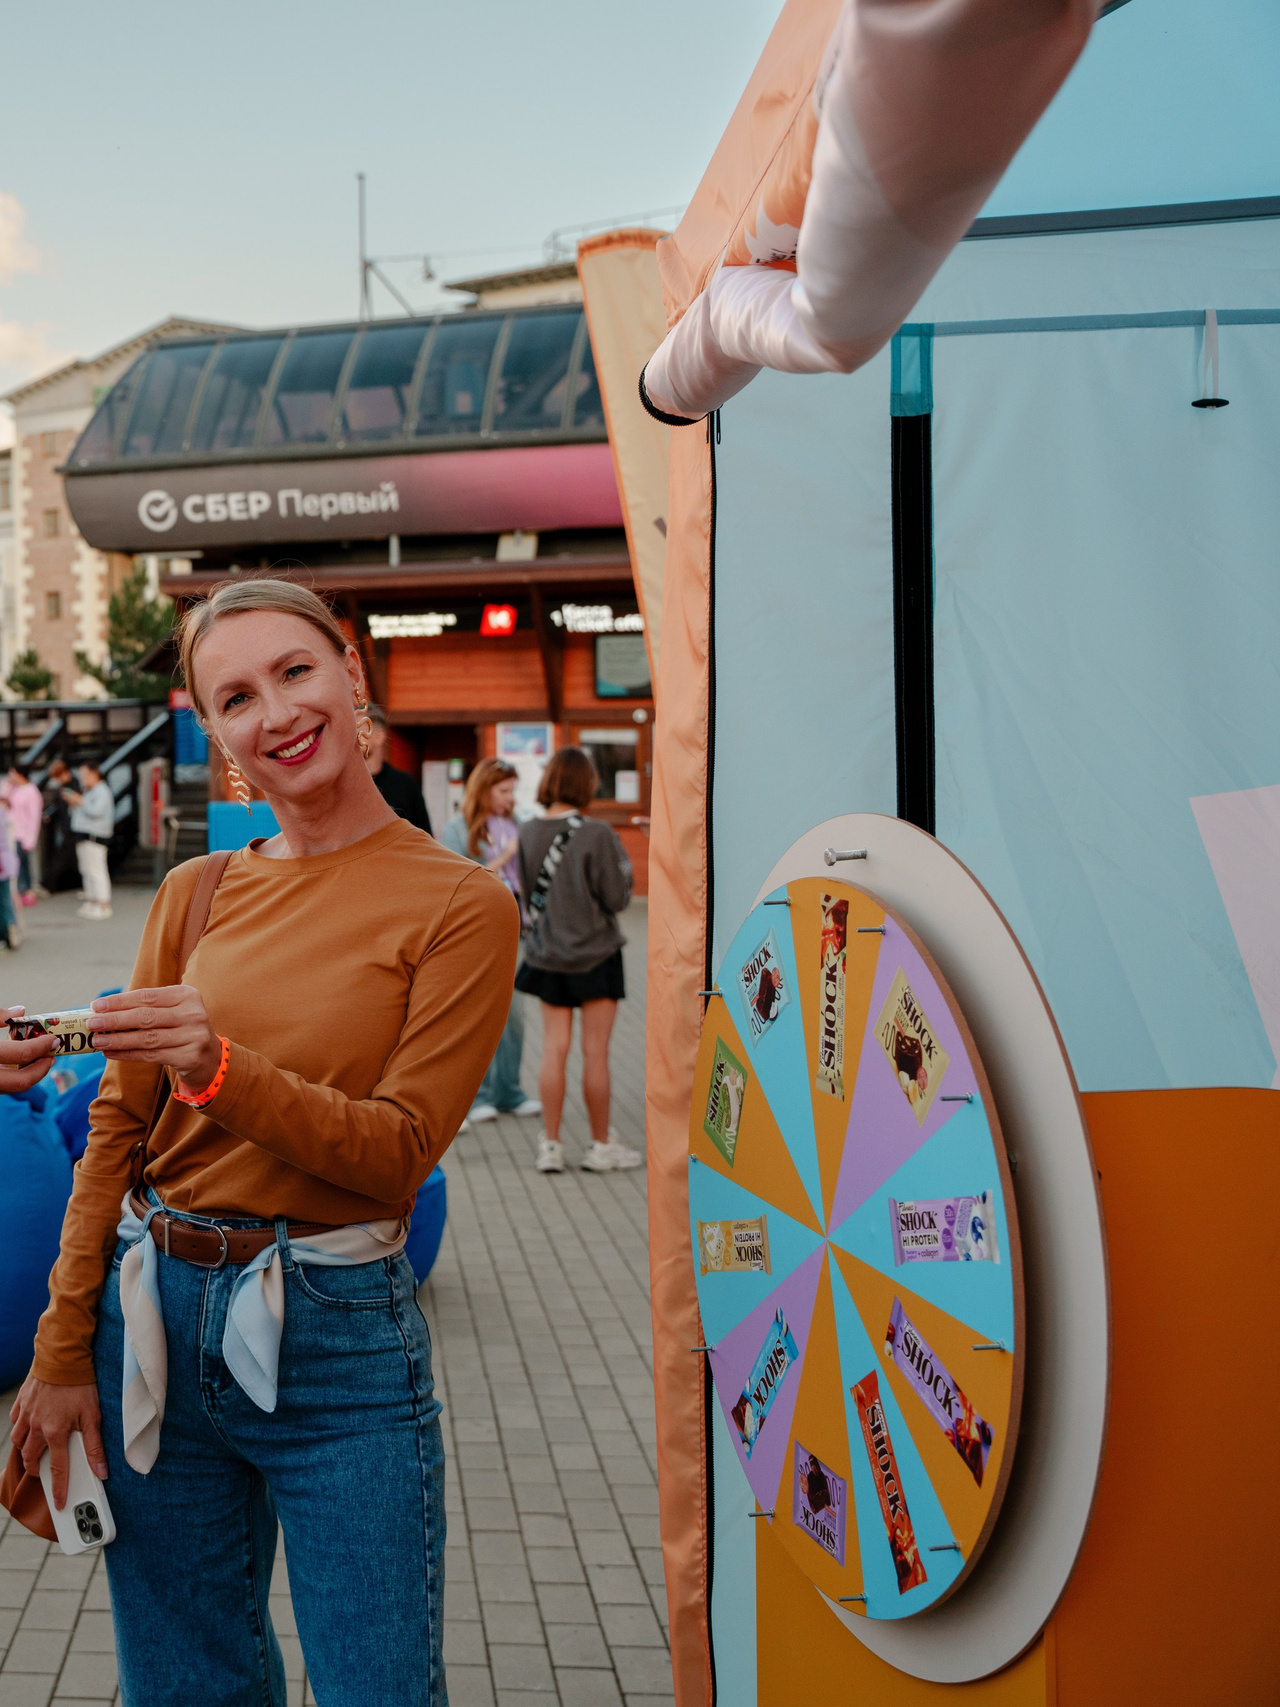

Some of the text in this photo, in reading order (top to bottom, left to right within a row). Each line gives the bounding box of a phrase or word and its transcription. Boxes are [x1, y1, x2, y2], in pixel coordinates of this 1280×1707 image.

[182, 481, 399, 523] СБЕР Первый
[744, 944, 772, 990] SHOCK
[825, 961, 838, 1071] SHOCK
[901, 992, 936, 1062] SHOCK
[734, 1232, 754, 1243] PROTEIN
[900, 1211, 937, 1232] SHOCK
[902, 1236, 910, 1247] HI
[911, 1234, 939, 1246] PROTEIN
[736, 1245, 763, 1262] SHOCK
[752, 1338, 785, 1411] SHOCK
[901, 1331, 956, 1420] SHOCK
[866, 1405, 903, 1522] SHOCK
[802, 1506, 836, 1549] SHOCK
